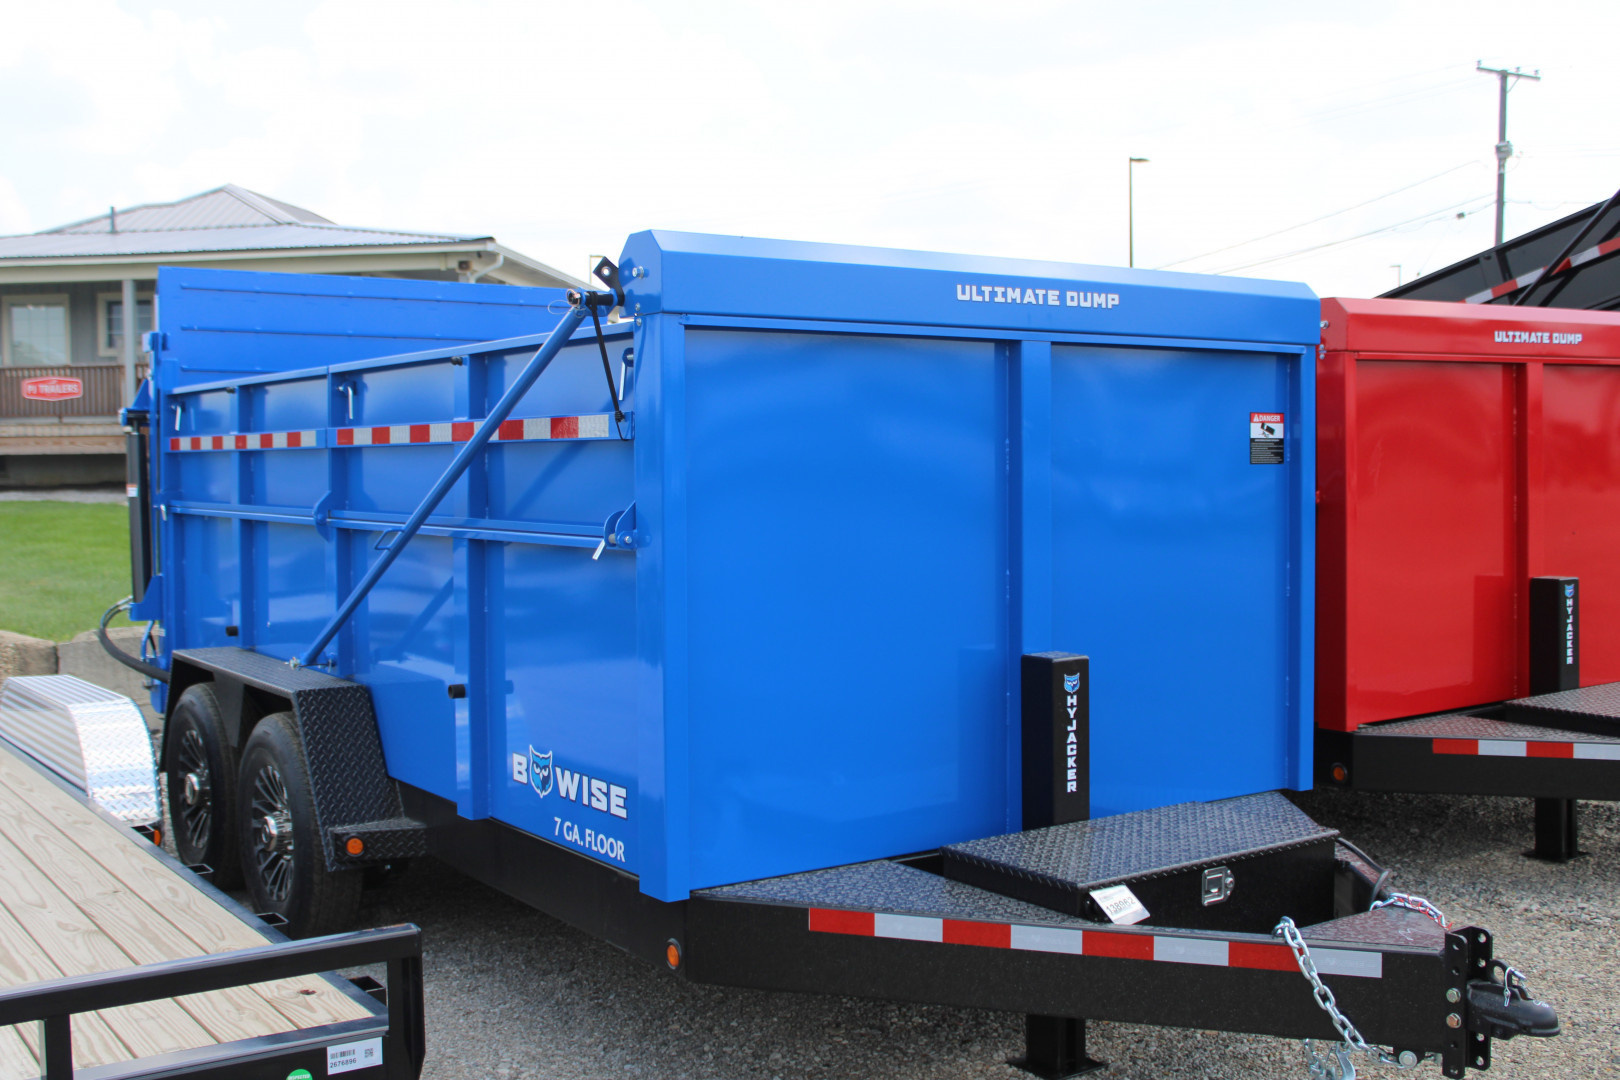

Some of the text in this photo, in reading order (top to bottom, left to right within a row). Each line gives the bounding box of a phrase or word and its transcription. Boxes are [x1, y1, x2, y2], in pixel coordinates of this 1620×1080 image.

[956, 284, 1120, 309] ULTIMATE DUMP
[1494, 330, 1583, 345] ULTIMATE DUMP
[38, 383, 79, 394] TRAILERS
[1259, 414, 1281, 422] DANGER
[1565, 598, 1574, 665] HYJACKER
[1066, 694, 1078, 793] HYJACKER
[553, 816, 626, 863] 7 GA. FLOOR
[329, 1057, 357, 1069] 2676896
